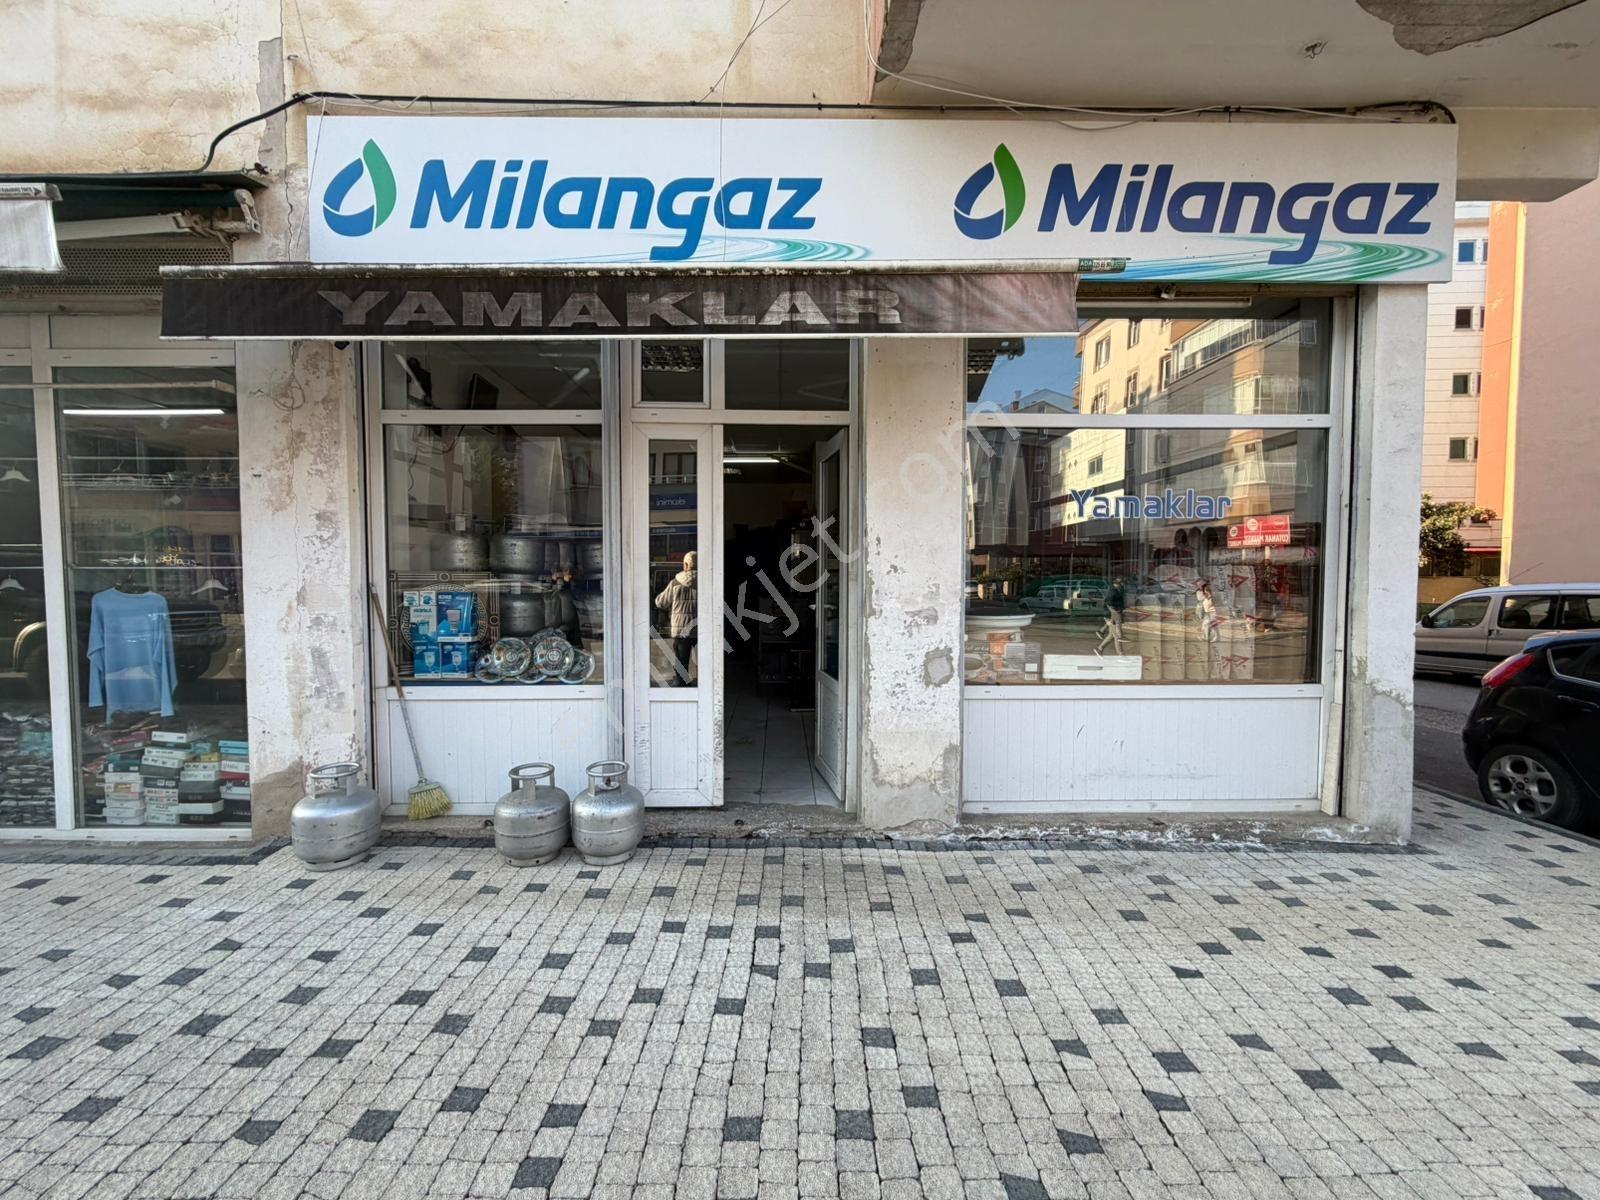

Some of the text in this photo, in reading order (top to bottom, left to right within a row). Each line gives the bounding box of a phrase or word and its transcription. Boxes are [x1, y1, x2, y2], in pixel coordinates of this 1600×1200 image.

[410, 159, 823, 261] Milangaz
[1037, 163, 1438, 265] Milangaz
[316, 288, 904, 327] YAMAKLAR
[1070, 488, 1233, 519] Yamaklar
